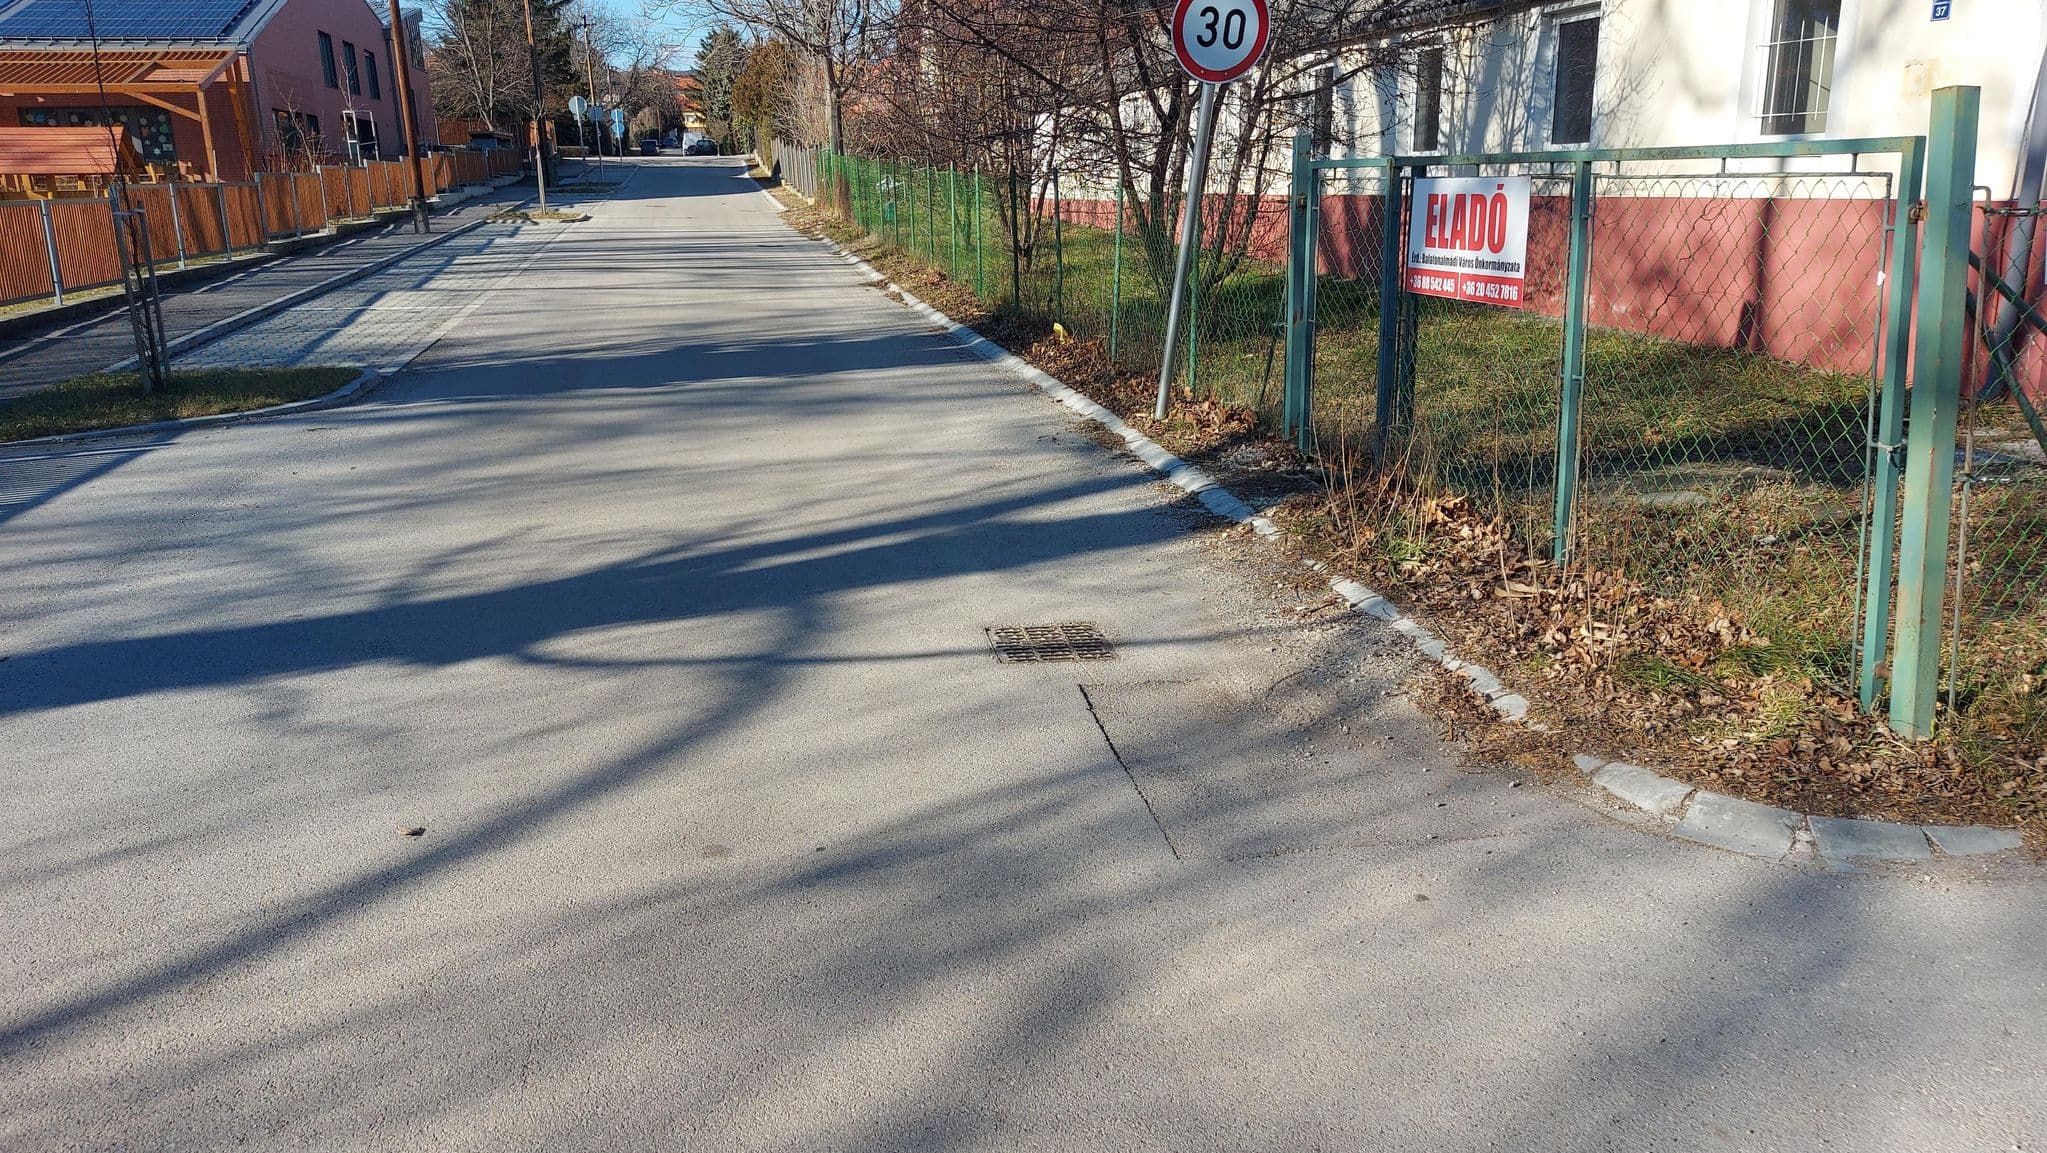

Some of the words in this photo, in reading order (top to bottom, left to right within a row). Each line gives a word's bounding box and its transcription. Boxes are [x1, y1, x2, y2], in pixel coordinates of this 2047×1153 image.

[1935, 6, 1946, 17] 37
[1196, 6, 1246, 50] 30
[1424, 183, 1508, 254] ELADÓ
[1422, 253, 1458, 267] Balatonalmádi
[1459, 256, 1474, 269] Város
[1475, 256, 1520, 273] Önkormányzata
[1410, 275, 1421, 288] +36
[1431, 277, 1442, 291] 542
[1443, 278, 1455, 293] 445
[1462, 280, 1475, 296] +36
[1476, 282, 1485, 297] 20
[1486, 283, 1499, 298] 452
[1501, 284, 1518, 301] 7816
